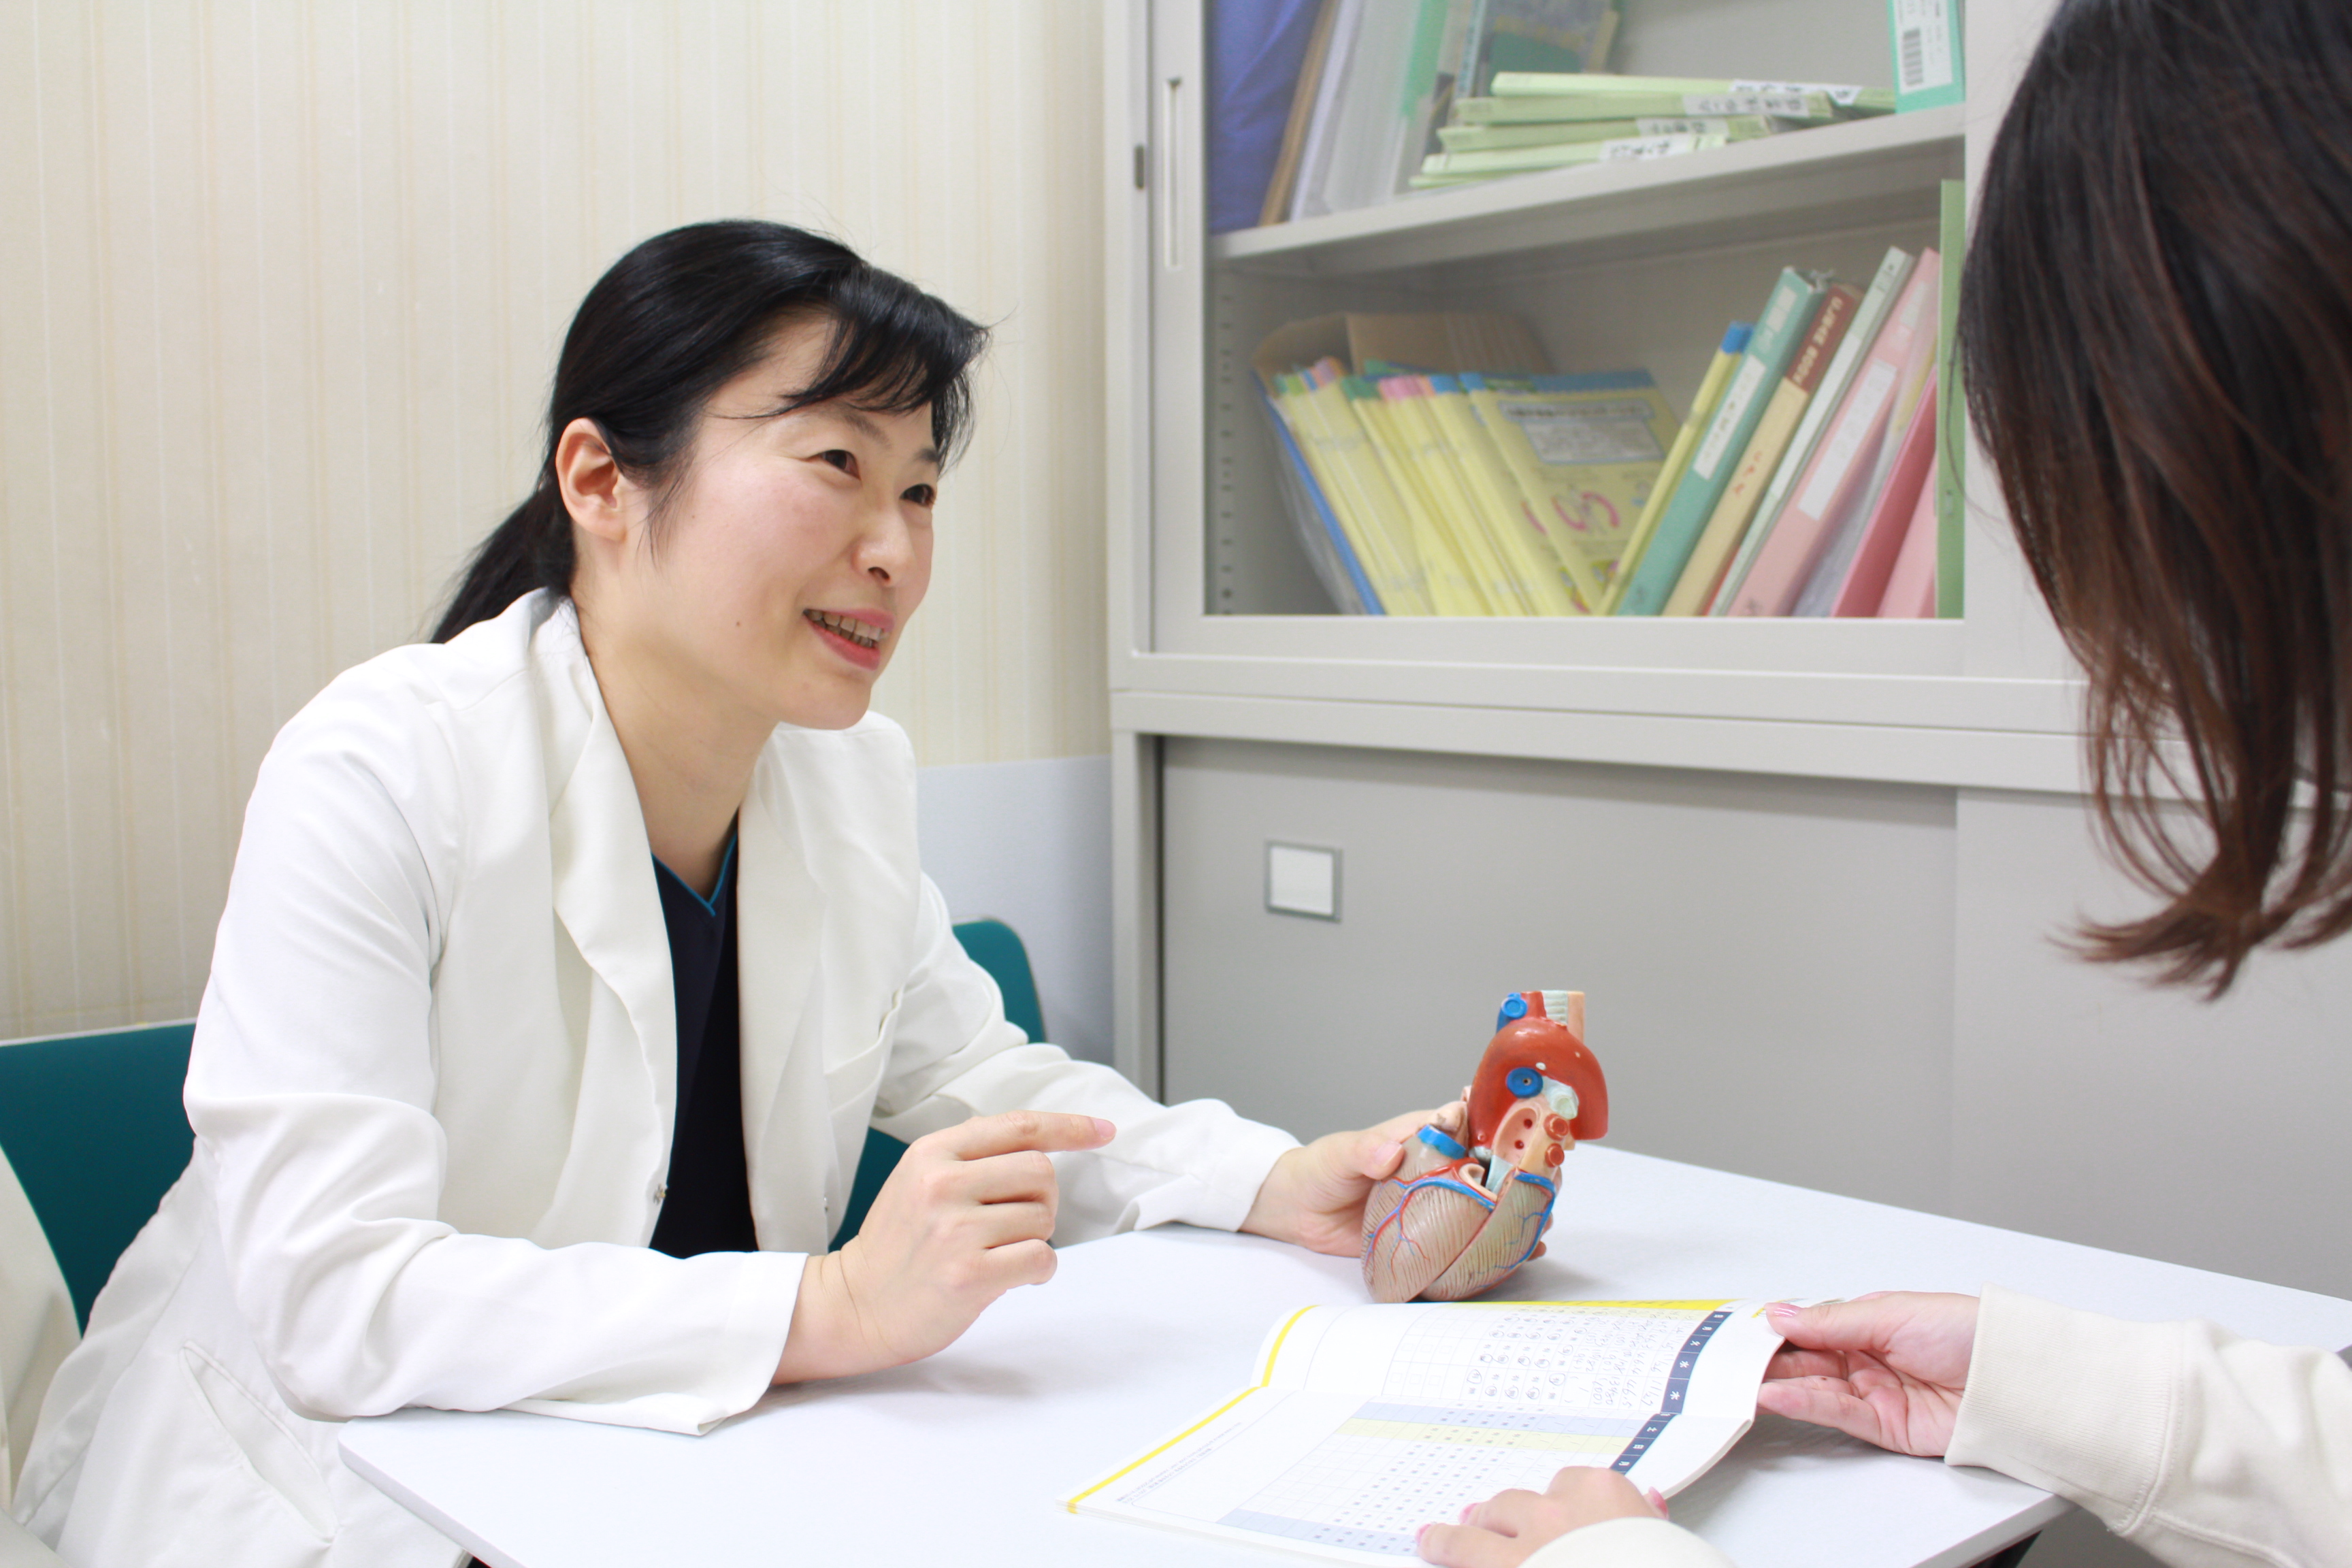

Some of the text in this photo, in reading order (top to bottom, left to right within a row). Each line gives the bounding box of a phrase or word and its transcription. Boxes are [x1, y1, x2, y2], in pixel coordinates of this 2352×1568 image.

[1679, 1360, 1690, 1369] 水
[1622, 1379, 1637, 1408] 46.5
[1640, 1379, 1663, 1406] 11/27
[1669, 1390, 1680, 1401] 木
